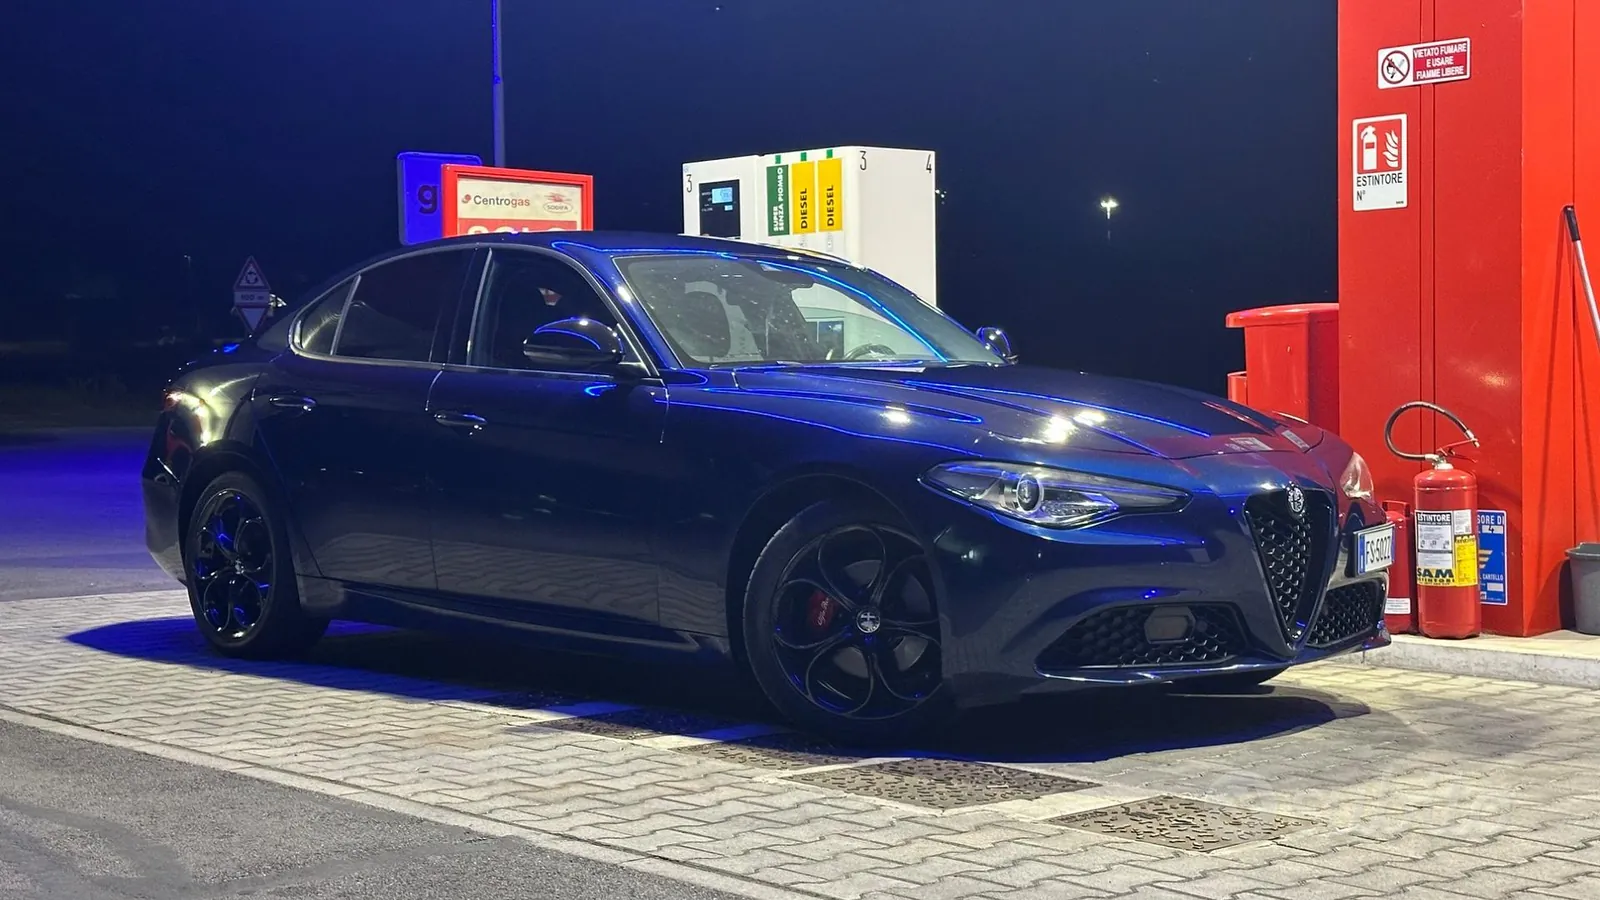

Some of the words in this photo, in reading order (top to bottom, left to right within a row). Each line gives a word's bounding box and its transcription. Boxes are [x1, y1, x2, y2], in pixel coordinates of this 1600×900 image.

[1414, 47, 1439, 58] VIETATO
[1440, 43, 1467, 55] FUMARE
[1426, 59, 1431, 67] E
[1432, 56, 1454, 67] USARE
[1416, 68, 1440, 80] FIAMME
[1441, 66, 1464, 76] LIBERE
[859, 150, 867, 171] 3
[925, 154, 932, 174] 4
[686, 173, 693, 193] 3
[1356, 172, 1403, 187] ESTINTORE
[473, 195, 530, 208] Centrogas
[800, 188, 808, 229] DIESEL
[826, 185, 834, 227] DIESEL
[1417, 567, 1454, 578] SAM
